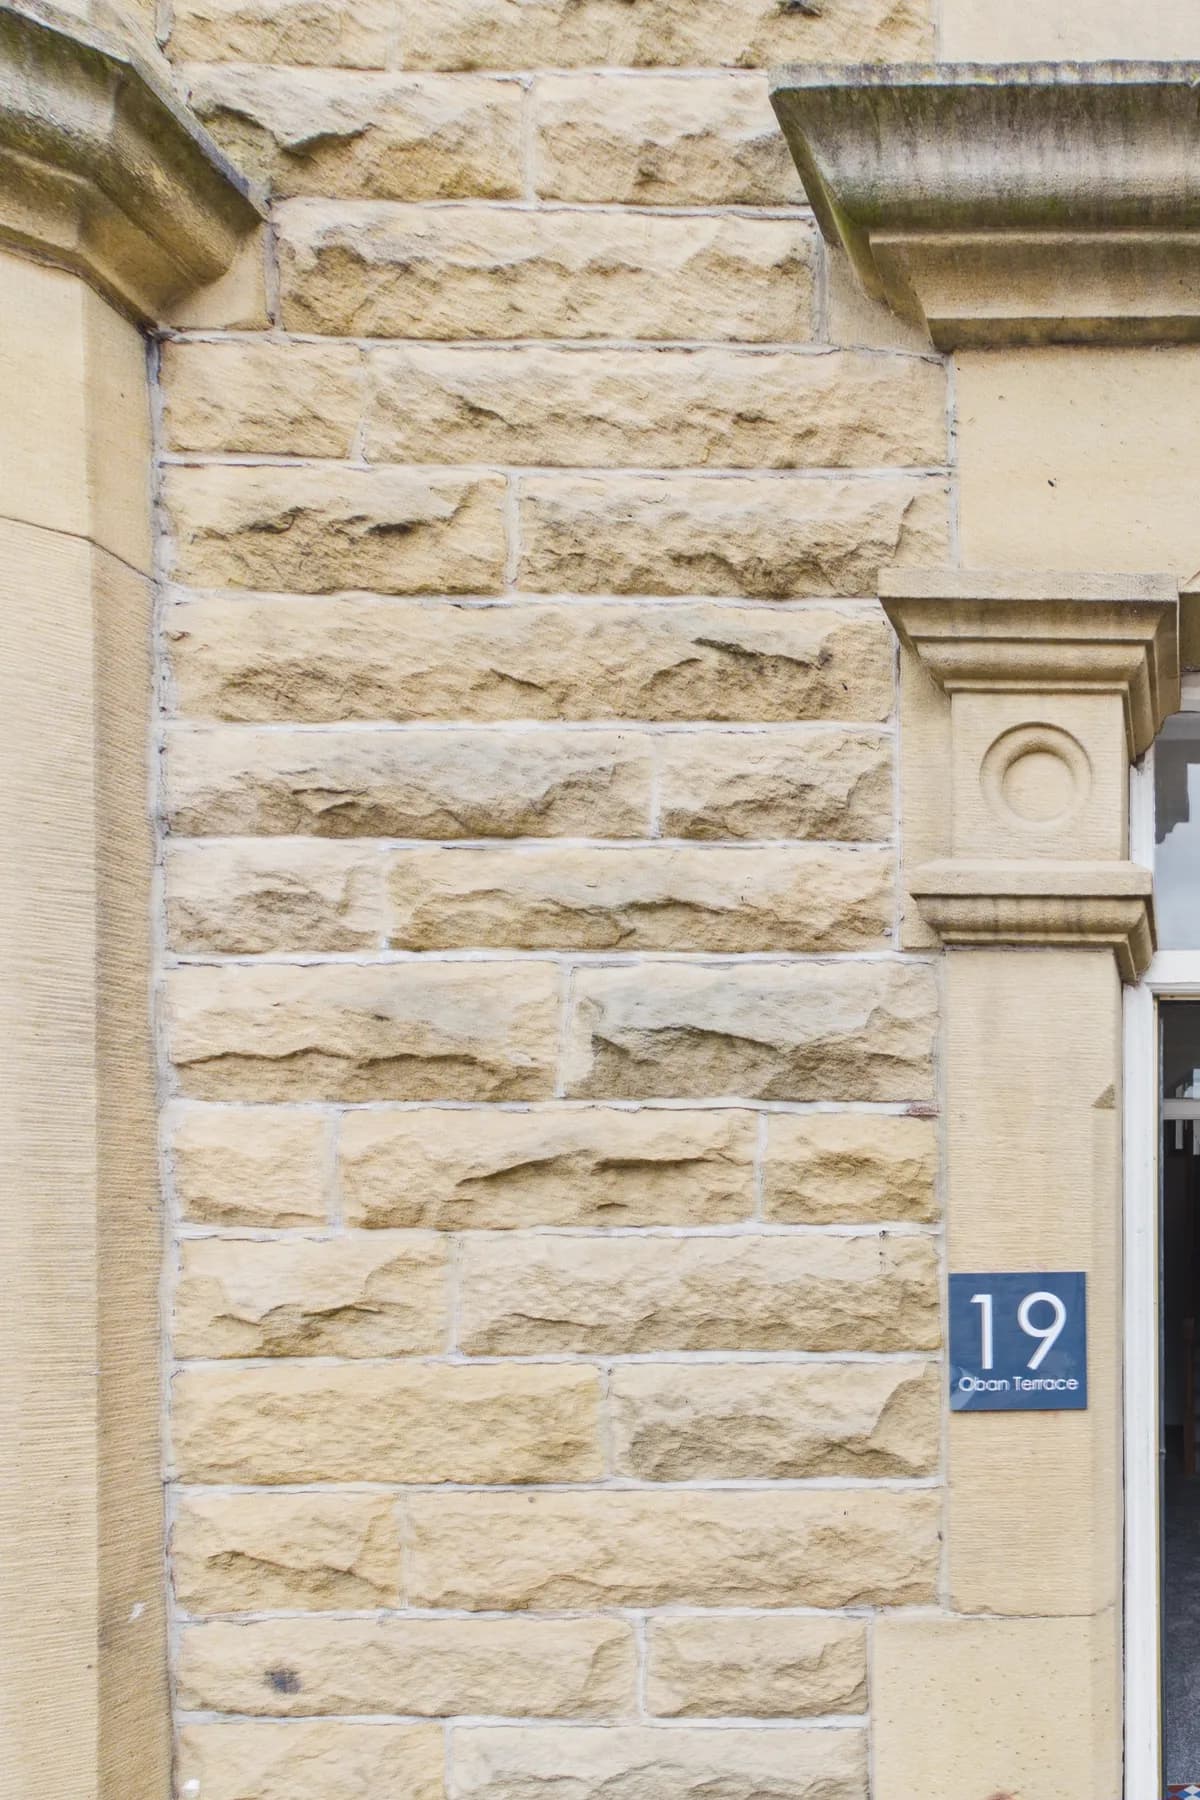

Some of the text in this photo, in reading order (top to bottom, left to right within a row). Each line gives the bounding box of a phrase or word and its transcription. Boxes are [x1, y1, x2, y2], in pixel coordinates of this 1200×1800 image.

[970, 1291, 1067, 1370] 19
[958, 1376, 1079, 1391] Oban Terrace
